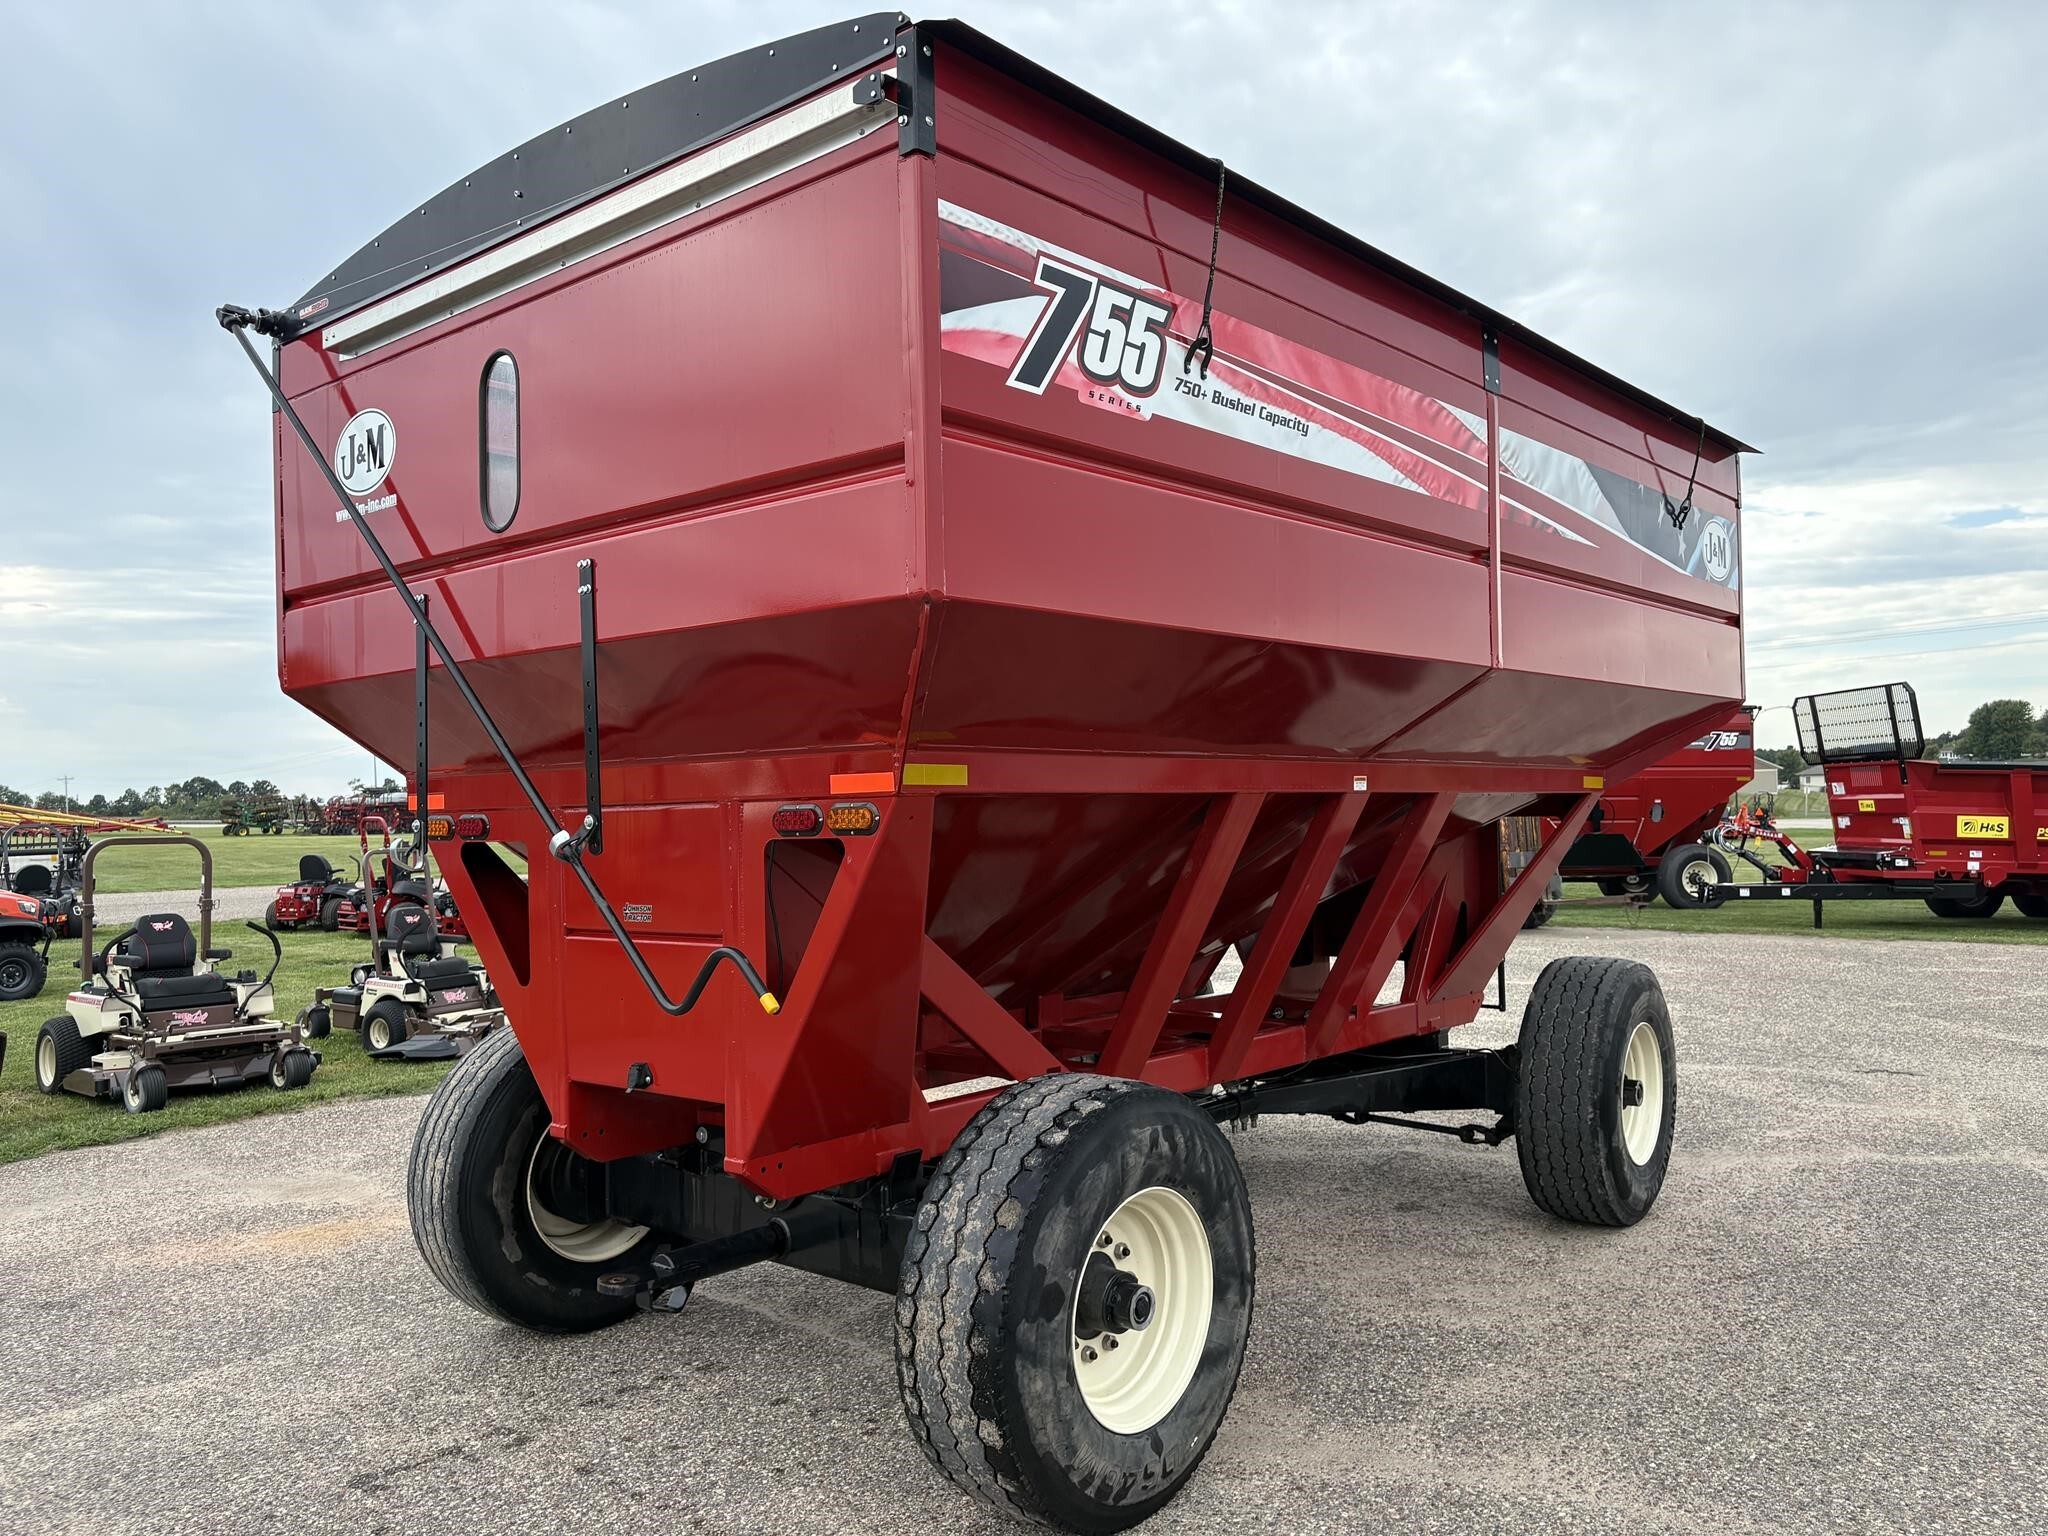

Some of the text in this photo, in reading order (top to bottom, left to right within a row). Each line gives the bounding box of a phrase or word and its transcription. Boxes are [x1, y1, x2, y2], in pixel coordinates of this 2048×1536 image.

[1005, 255, 1171, 396] 755
[1088, 390, 1142, 413] SERIES
[1174, 377, 1310, 437] 750+ Bushel Capacity
[341, 423, 385, 480] J&M
[336, 494, 397, 522] wwjm-inc.com
[1705, 532, 1727, 569] J&M
[1704, 731, 1739, 751] 755
[1980, 822, 2004, 833] H&S
[624, 902, 652, 911] JOHNSON
[624, 912, 652, 921] TRACTOR
